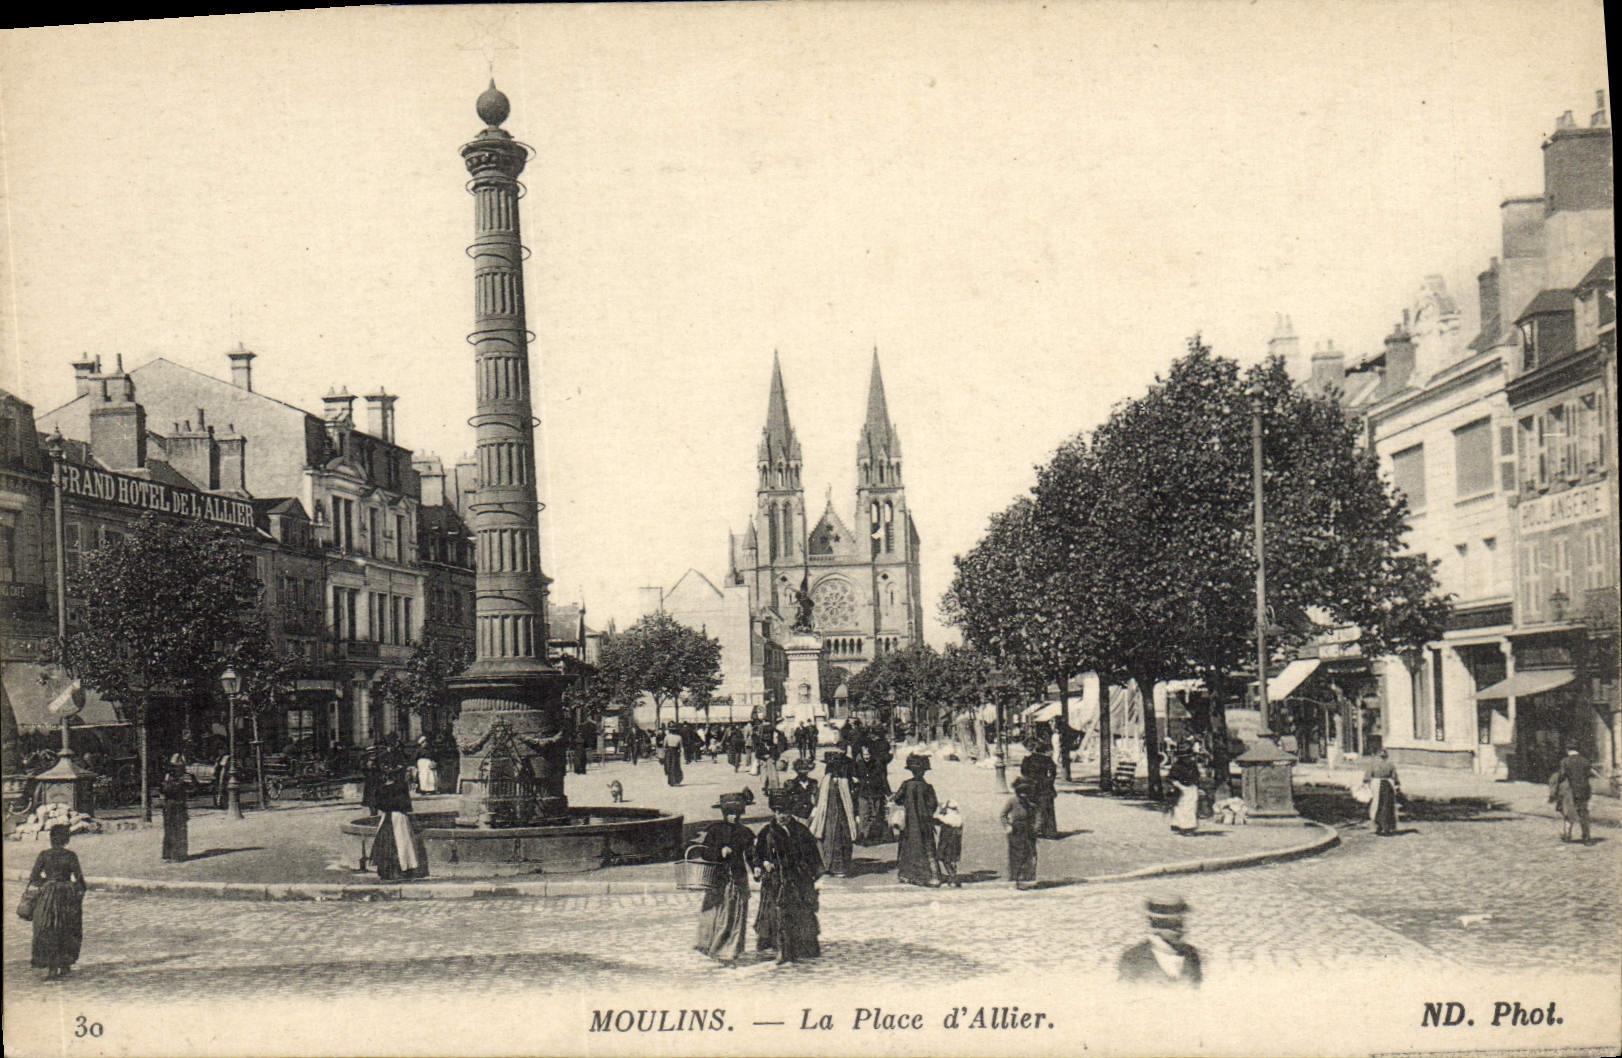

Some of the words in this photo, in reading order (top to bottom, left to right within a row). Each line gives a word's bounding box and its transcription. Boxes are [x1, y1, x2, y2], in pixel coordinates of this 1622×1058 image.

[60, 464, 115, 501] GRAND
[118, 476, 170, 511] HOTEL
[172, 490, 189, 515] DE
